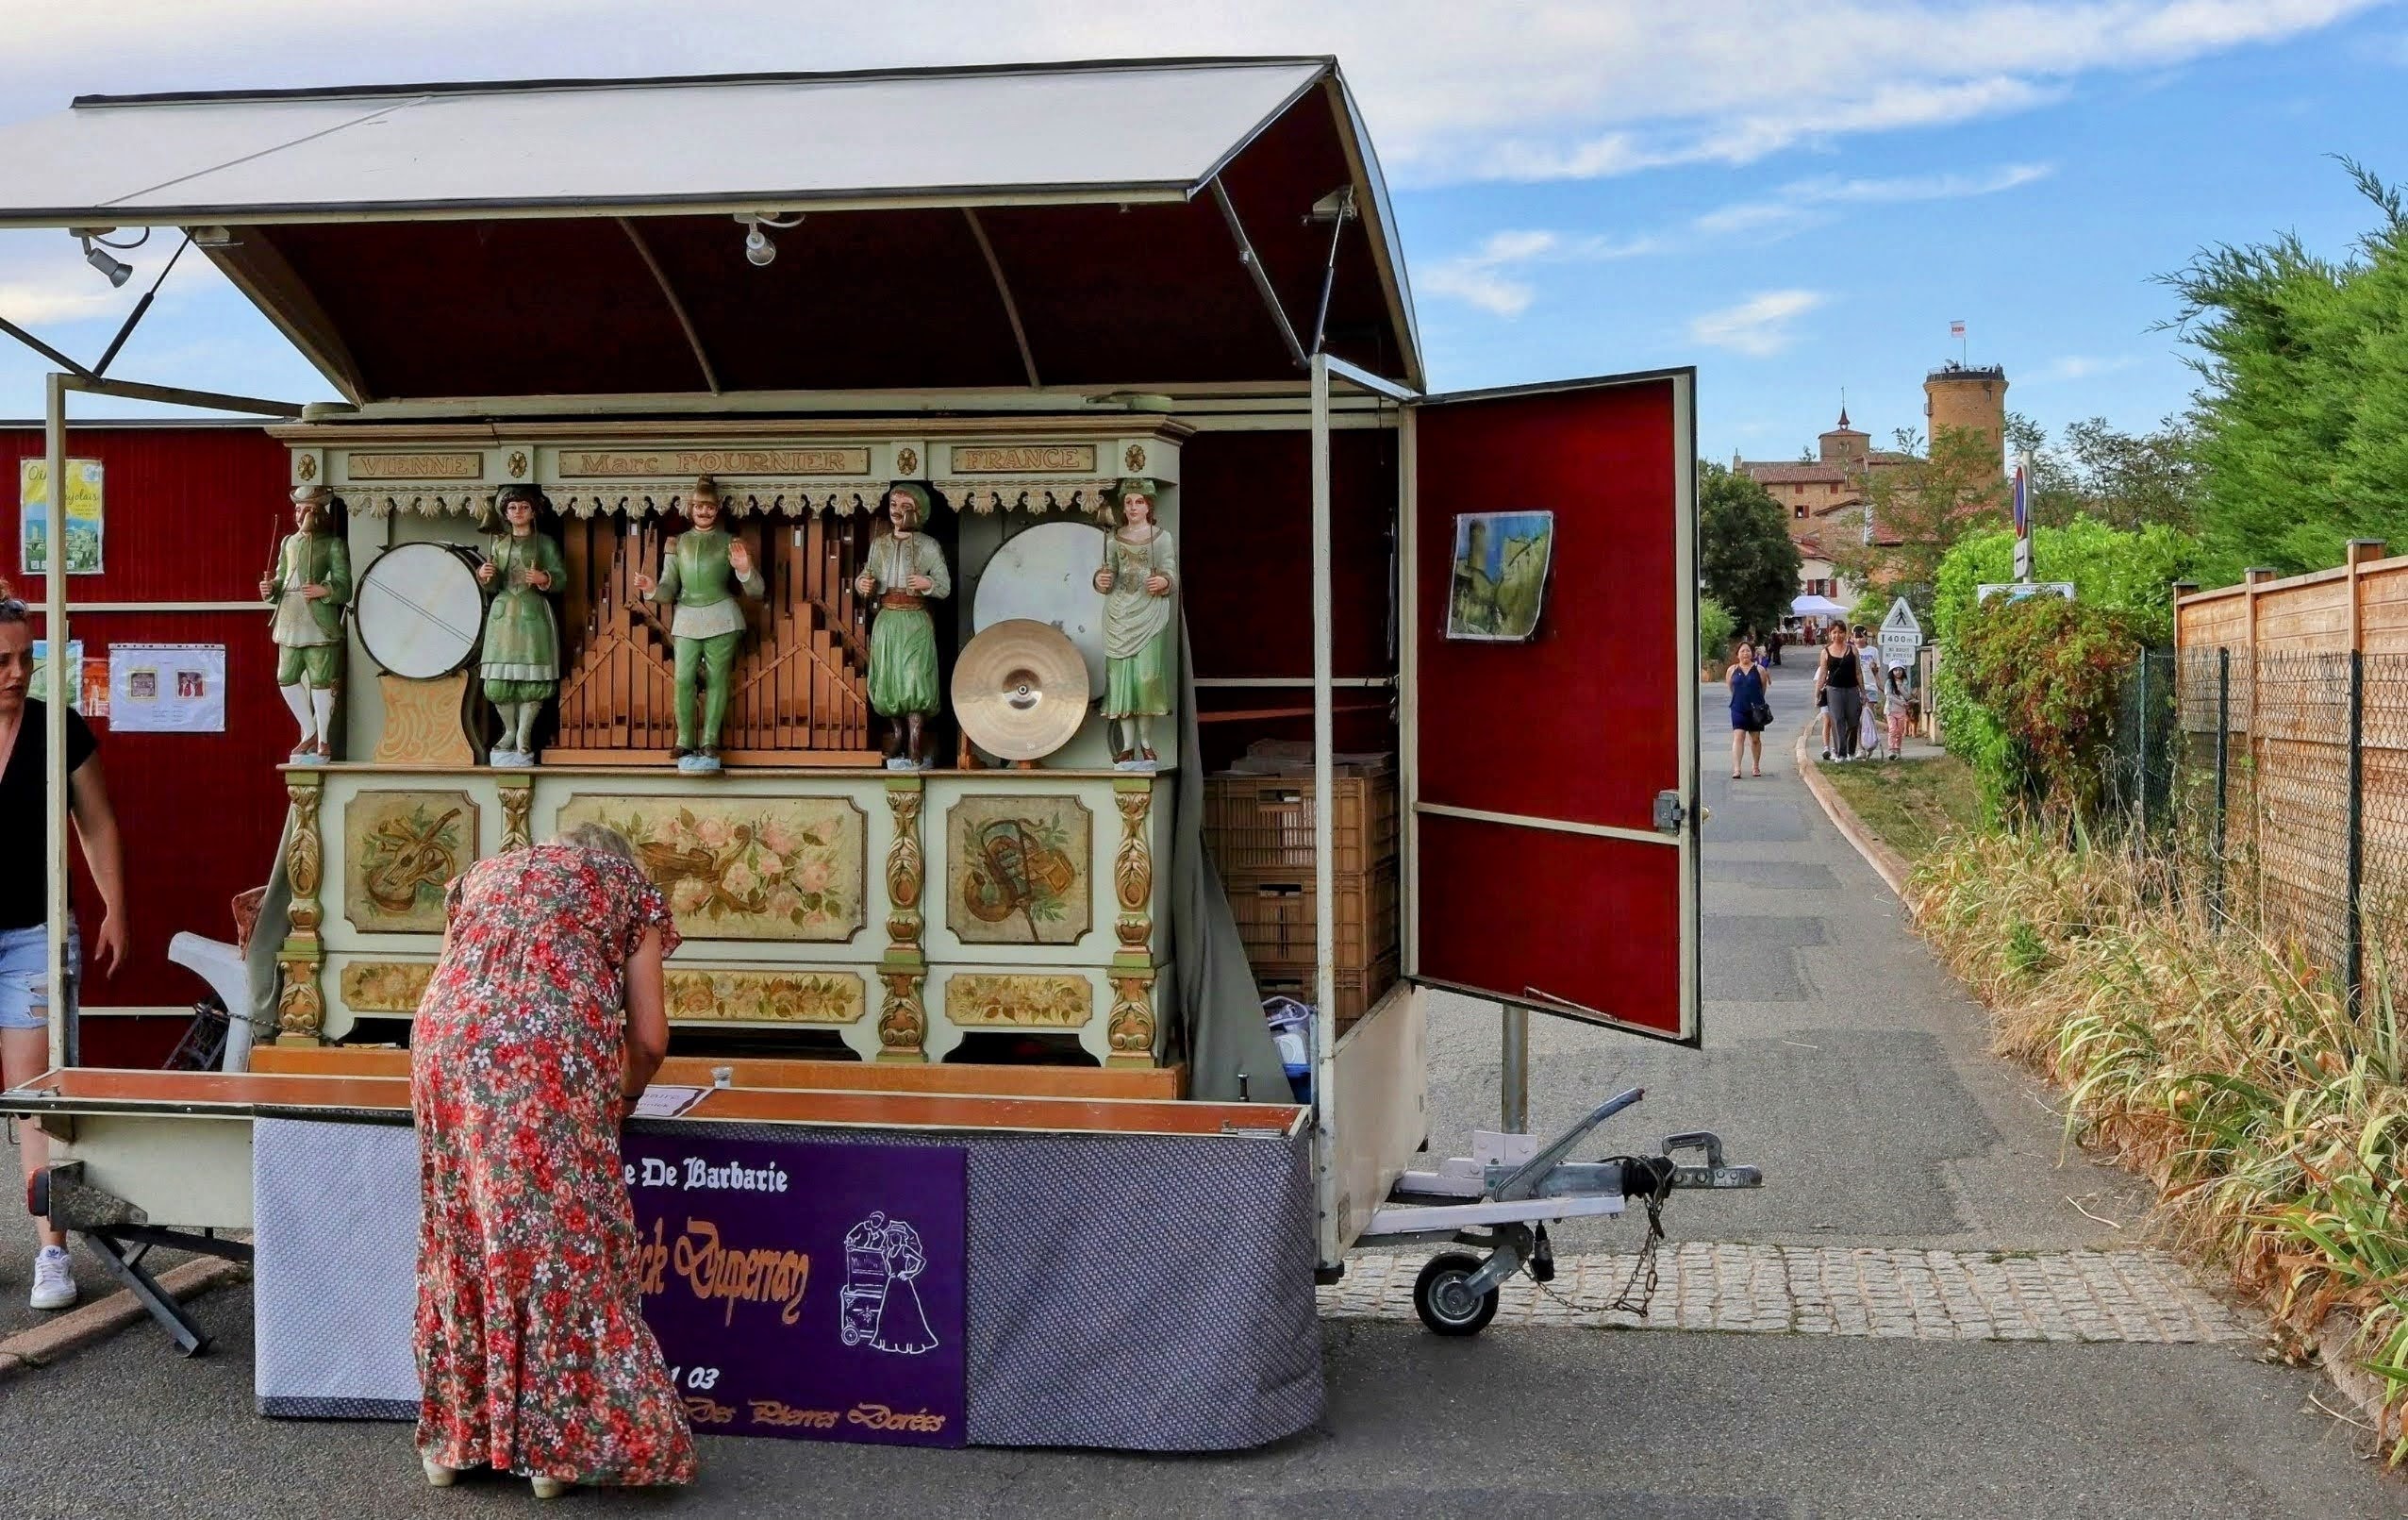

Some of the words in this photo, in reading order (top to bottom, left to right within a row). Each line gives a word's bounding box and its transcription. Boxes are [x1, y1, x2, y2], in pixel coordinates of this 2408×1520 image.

[361, 456, 468, 476] VIENNE
[580, 454, 659, 474] Marc
[675, 452, 845, 473] FOURNIER
[965, 448, 1080, 470] FRANCE
[641, 1157, 677, 1187] De
[683, 1156, 789, 1193] Barbarie
[688, 1366, 720, 1389] 03
[747, 1398, 840, 1428] Pierres
[848, 1402, 946, 1432] Dorées
